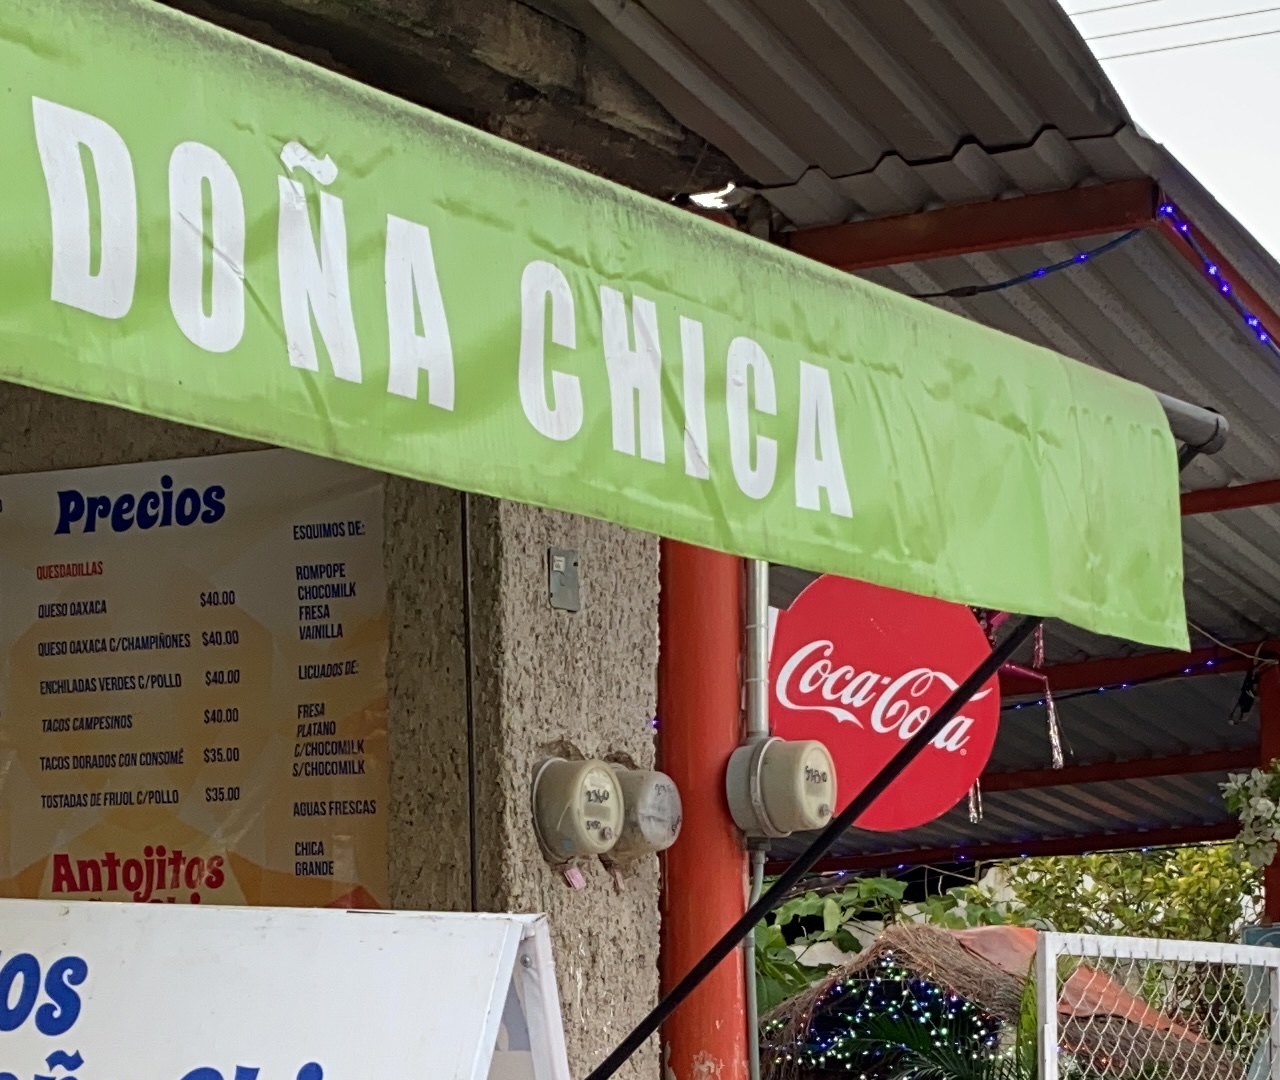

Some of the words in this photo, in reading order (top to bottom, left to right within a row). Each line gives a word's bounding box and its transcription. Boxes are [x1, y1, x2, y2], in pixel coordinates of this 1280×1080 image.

[32, 96, 455, 411] DOÑA
[521, 259, 853, 518] CHICA
[54, 474, 226, 535] Precios
[293, 521, 346, 540] ESQUIMOS
[347, 519, 366, 536] DE:
[36, 561, 103, 580] QUESDADILLAS
[295, 563, 346, 580] ROMPOPE
[297, 582, 356, 601] CHOCOMILK
[38, 602, 67, 619] QUESO
[70, 600, 107, 616] OAXACA
[200, 590, 235, 607] $40.00
[299, 604, 330, 620] FRESA
[299, 623, 343, 640] VAINILLA
[38, 641, 67, 657] QUESO
[70, 637, 108, 655] OAXACA
[109, 632, 191, 653] C/CHAMPIÑONES
[202, 630, 239, 647] $40.00
[298, 662, 343, 680] LICUADOS
[40, 677, 97, 696] ENCHILADAS
[98, 675, 136, 692] VERDES
[138, 673, 182, 690] C/POLLO
[205, 669, 240, 686] $40.00
[776, 640, 993, 752] Coca-Coa
[297, 702, 325, 719] FRESA
[42, 717, 70, 733] TACOS
[72, 714, 133, 731] CAMPESINOS
[204, 708, 239, 725] $40.00
[296, 721, 336, 738] PLATANO
[294, 739, 365, 758] C/CHOCOMILK
[40, 755, 70, 772] TACOS
[72, 753, 117, 770] DORADOS
[119, 751, 137, 768] CON
[139, 747, 184, 767] CONSOMÉ
[203, 747, 240, 764] $35.00
[292, 759, 365, 777] S/CHOCOMILK
[41, 793, 88, 809] TOSTADAS
[90, 792, 101, 807] DE
[103, 790, 134, 807] FRIJOL
[136, 789, 179, 806] C/POLLO
[205, 786, 240, 803] $35.00
[293, 801, 327, 817] AGUAS
[328, 799, 376, 816] FRESCAS
[294, 841, 324, 856] CHICA
[51, 844, 225, 903] Antojitos
[295, 861, 334, 876] GRANDE
